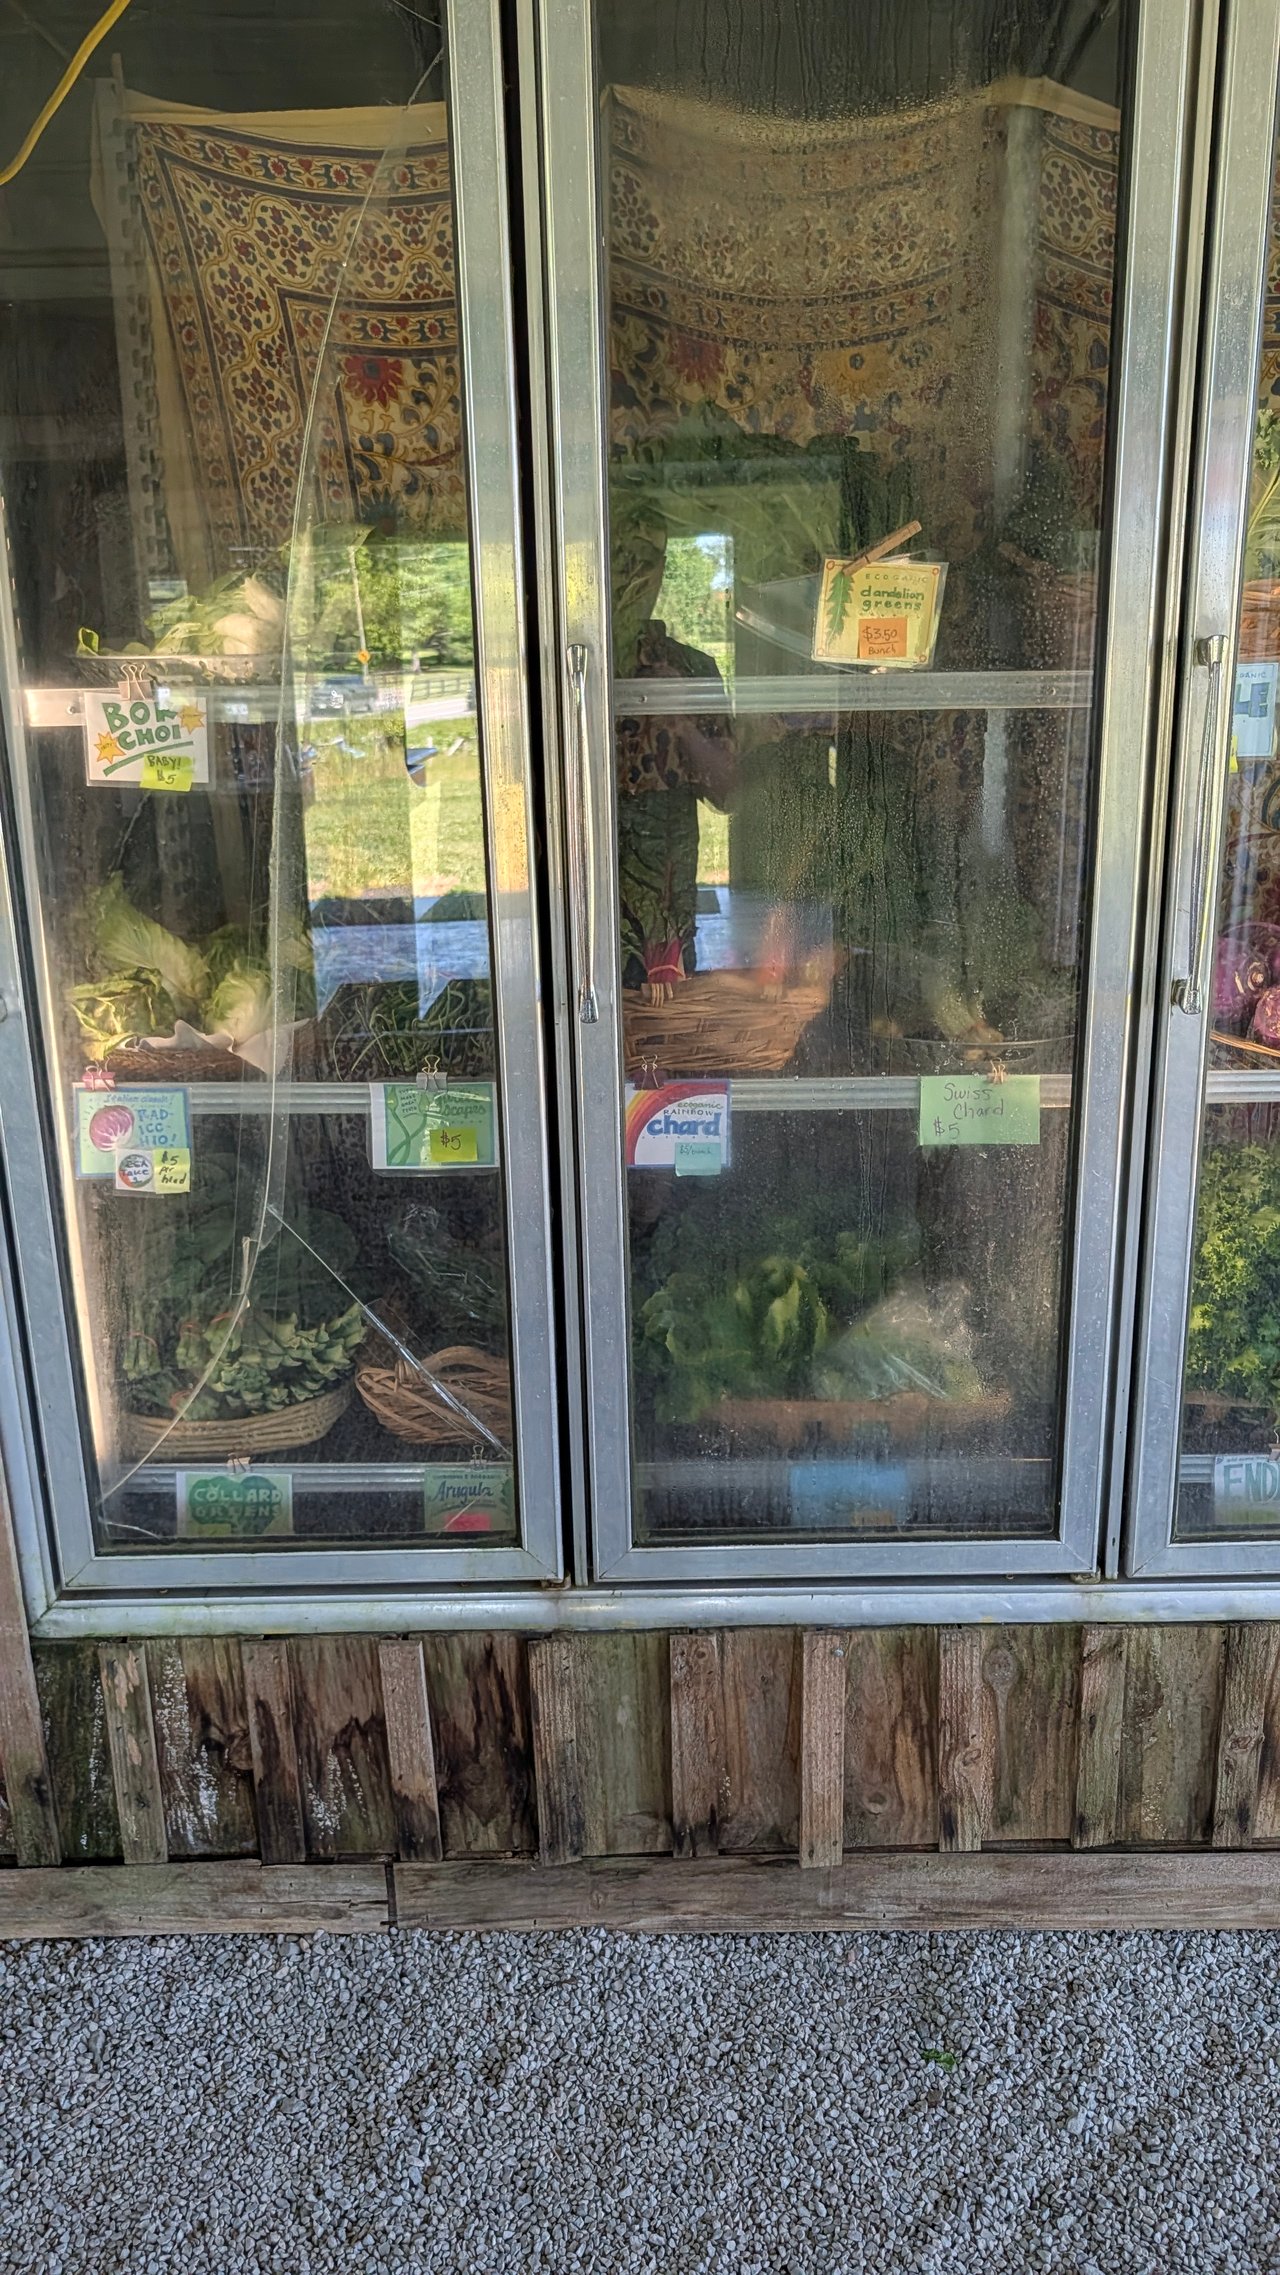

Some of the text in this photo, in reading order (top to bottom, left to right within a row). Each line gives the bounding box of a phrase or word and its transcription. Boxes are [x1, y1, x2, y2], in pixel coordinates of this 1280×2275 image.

[860, 585, 925, 601] dandelion
[862, 600, 922, 612] greens
[862, 626, 898, 642] $3.50
[868, 644, 897, 656] Bunch
[1240, 671, 1267, 679] GANIC
[1235, 682, 1270, 718] LE
[101, 701, 178, 734] BOK
[117, 723, 182, 750] CHOI
[147, 755, 182, 771] BABY!
[943, 1082, 993, 1102] Swiss
[663, 1109, 715, 1117] RAINBOW
[953, 1098, 1004, 1120] Chard
[646, 1112, 722, 1137] chard
[933, 1116, 960, 1140] $5
[440, 1130, 462, 1151] $5
[1223, 1462, 1280, 1502] END
[194, 1487, 283, 1503] COLLARD
[432, 1480, 494, 1506] Arugula
